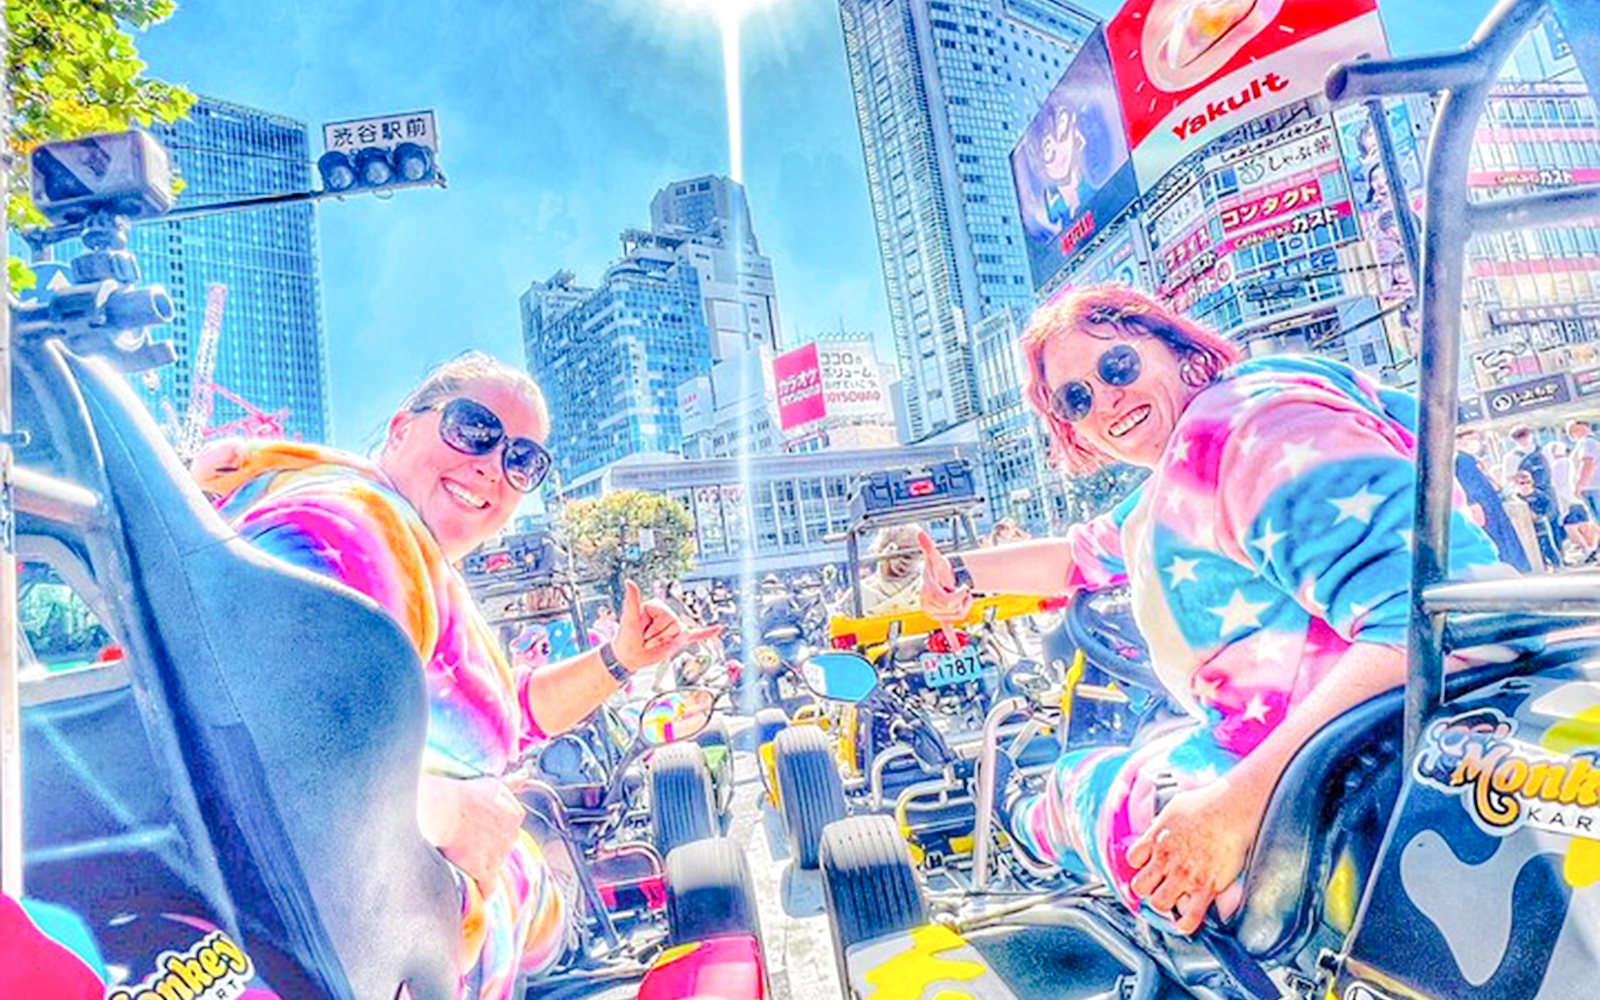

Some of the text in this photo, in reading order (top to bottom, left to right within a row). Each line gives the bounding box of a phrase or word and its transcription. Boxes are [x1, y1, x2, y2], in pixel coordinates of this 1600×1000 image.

[1171, 72, 1289, 142] Yakult
[333, 117, 427, 147] 渋谷駅前
[1222, 184, 1318, 230] コンタクト
[1291, 206, 1339, 234] ガスト
[1527, 807, 1592, 832] KAR
